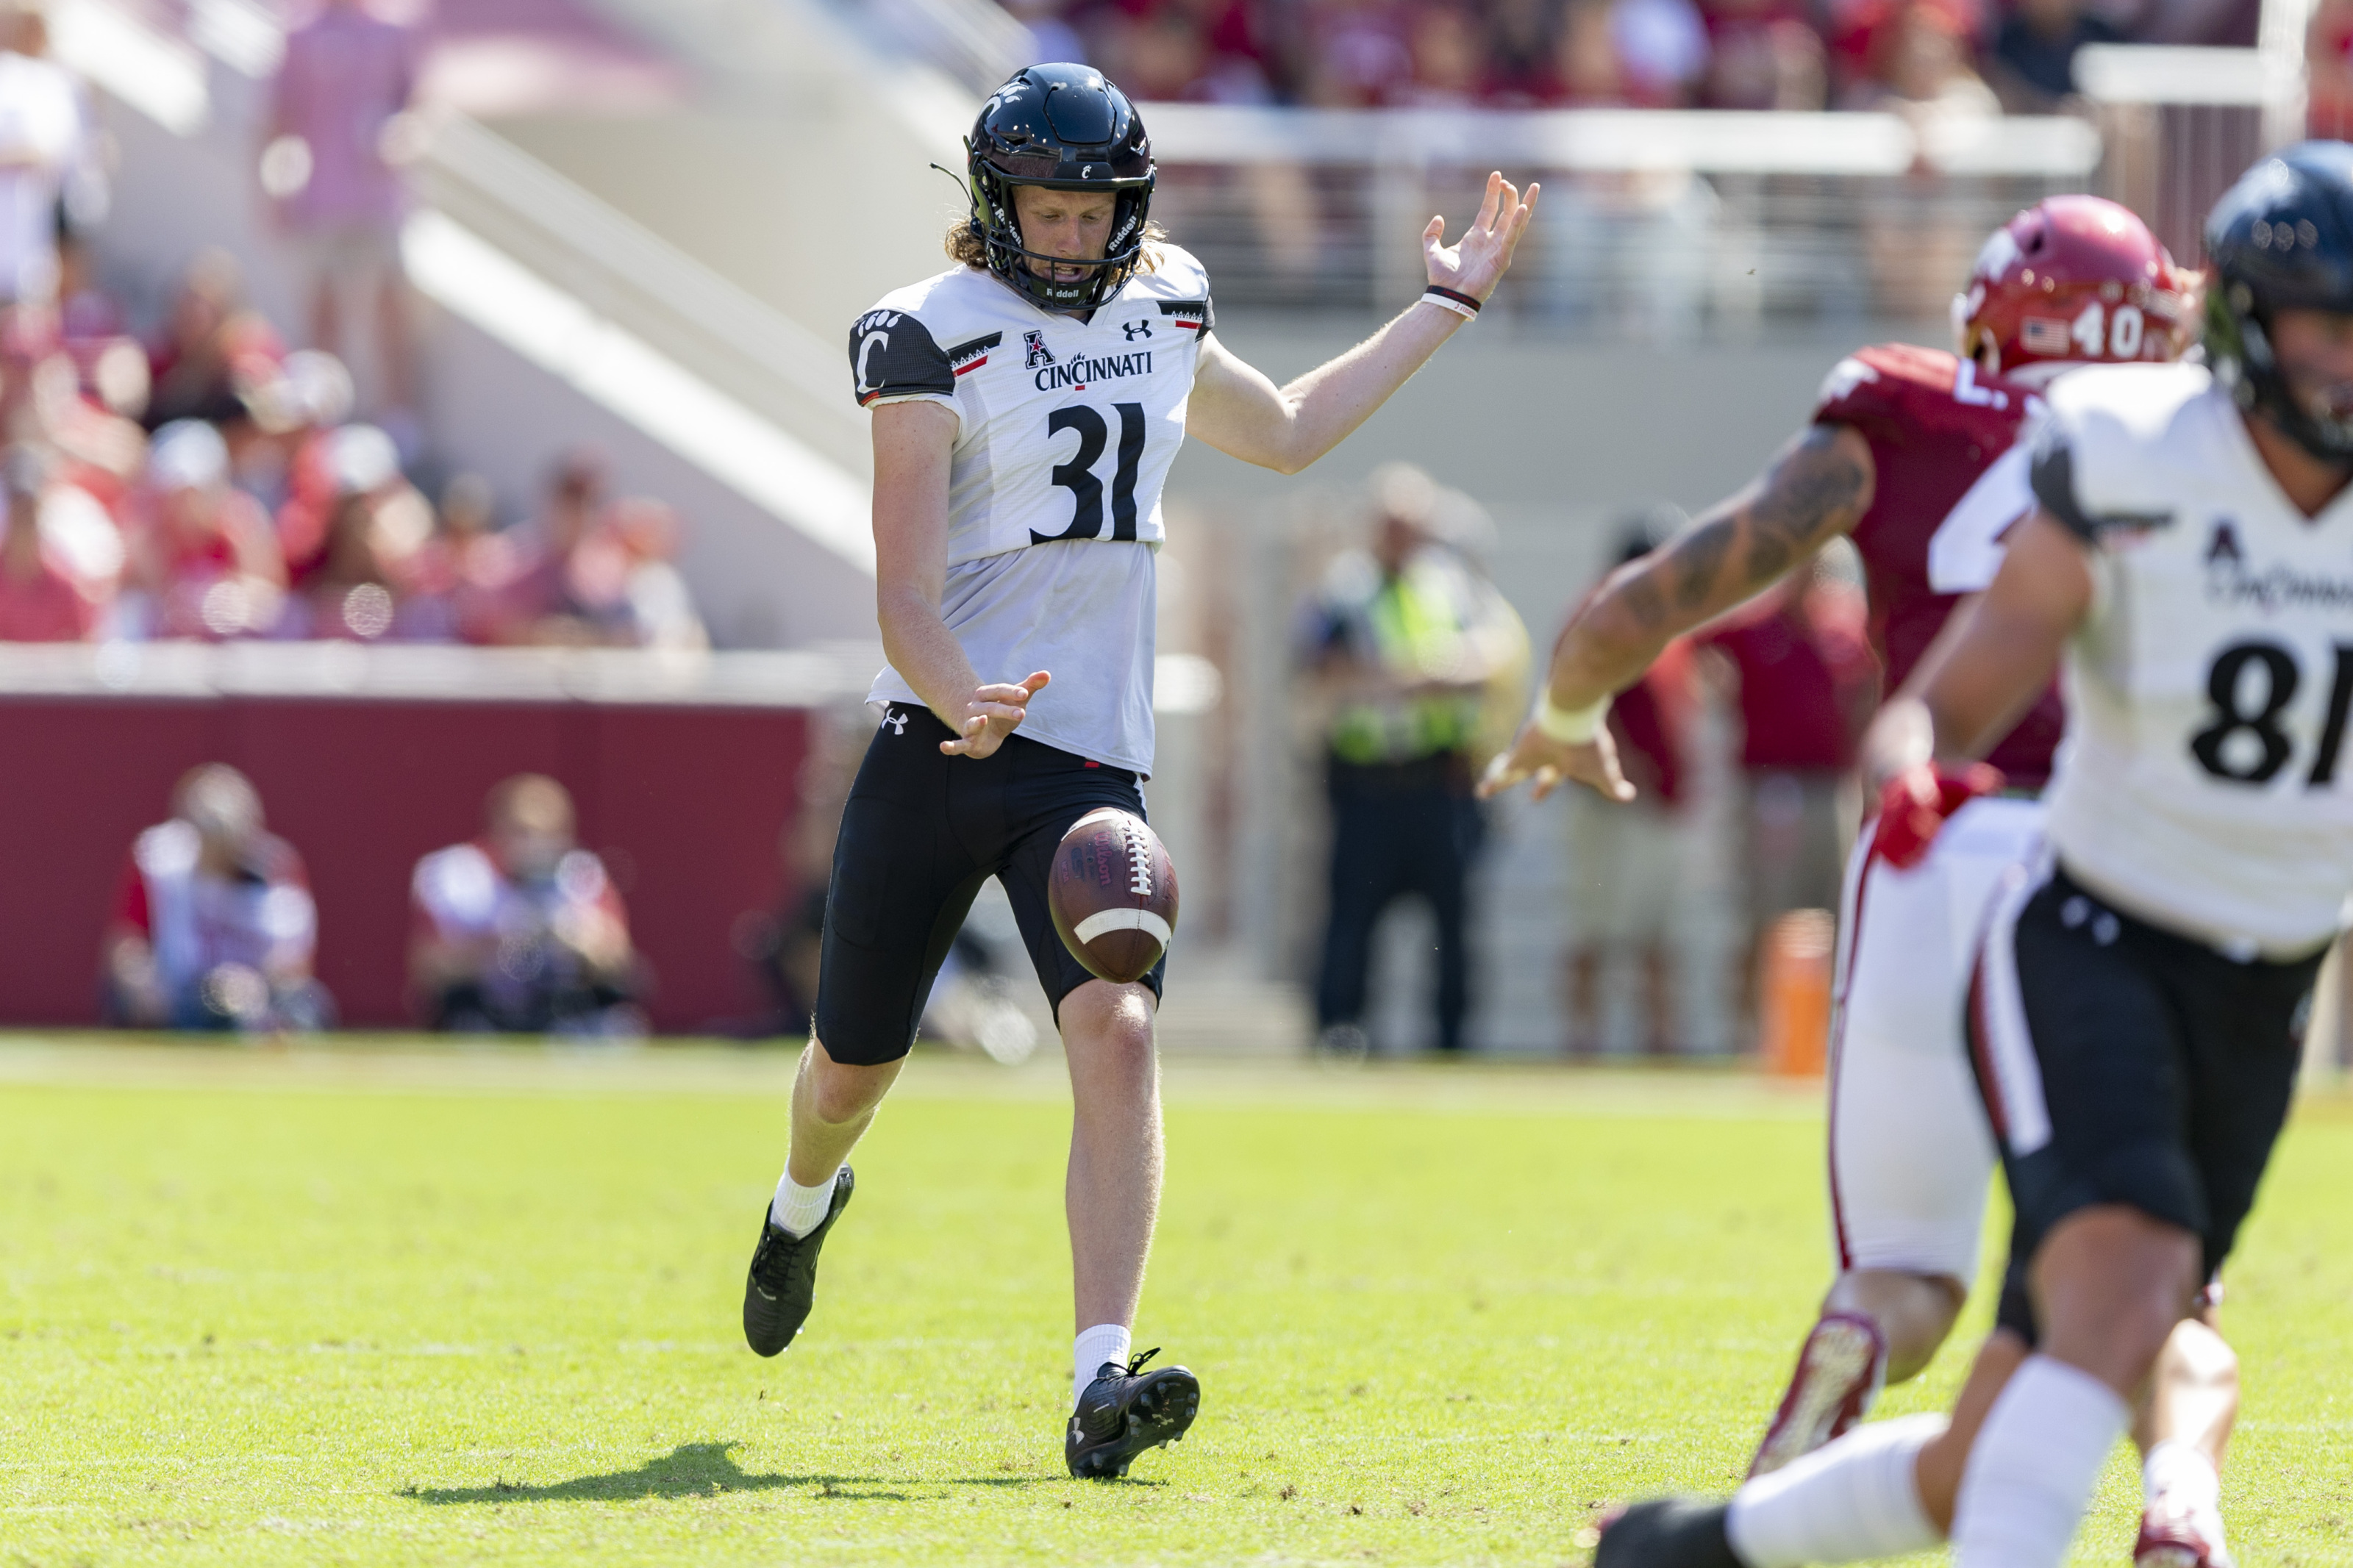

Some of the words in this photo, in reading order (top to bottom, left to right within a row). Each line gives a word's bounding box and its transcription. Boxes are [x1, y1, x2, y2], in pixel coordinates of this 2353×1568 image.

[1108, 215, 1137, 251] Riddell
[1046, 287, 1079, 298] Rddell
[1024, 330, 1055, 369] A
[2072, 301, 2143, 358] 40
[1035, 351, 1152, 391] CINCINNATI
[1029, 402, 1146, 545] 31
[2191, 641, 2353, 787] 81
[1094, 831, 1113, 886] Wilson
